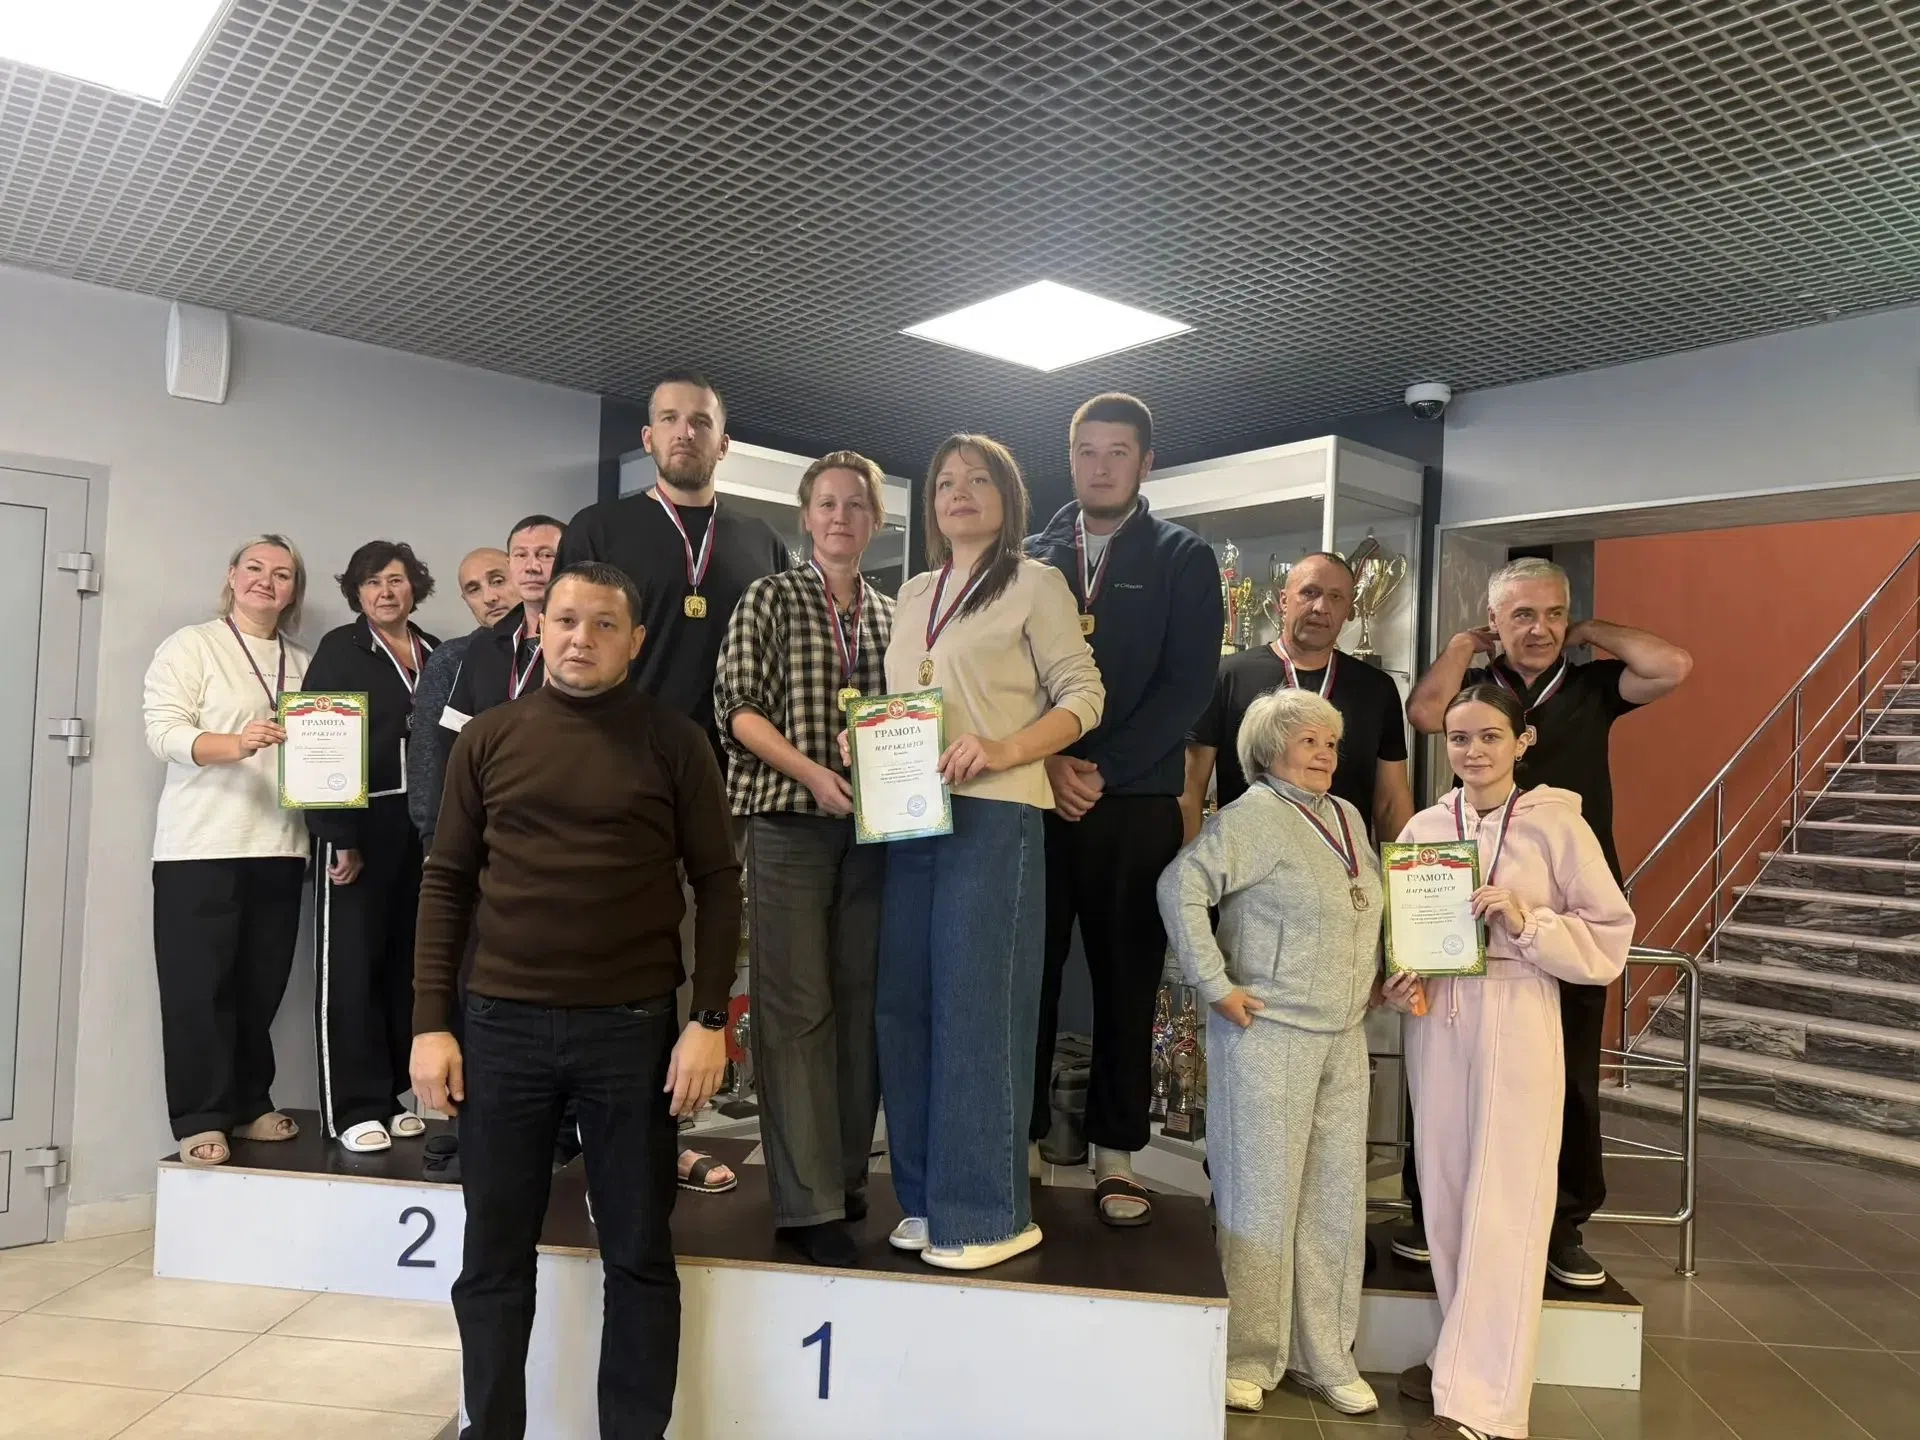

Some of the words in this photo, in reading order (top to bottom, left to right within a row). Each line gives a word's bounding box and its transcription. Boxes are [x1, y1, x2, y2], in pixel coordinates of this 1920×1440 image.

[874, 726, 921, 738] ГРАМОТА
[1406, 873, 1454, 882] ГРАМОТА
[397, 1206, 436, 1268] 2
[802, 1321, 831, 1399] 1
